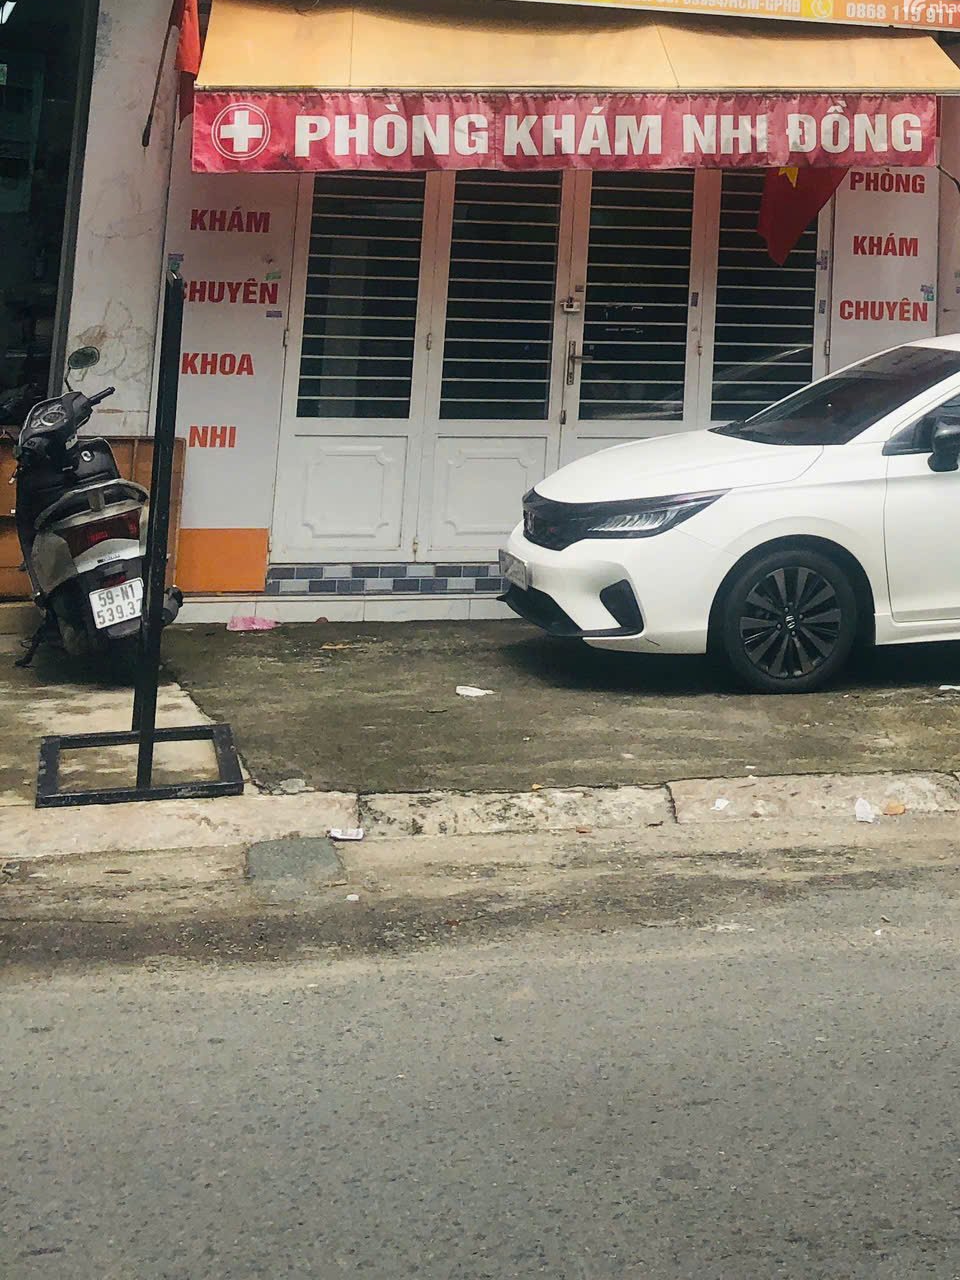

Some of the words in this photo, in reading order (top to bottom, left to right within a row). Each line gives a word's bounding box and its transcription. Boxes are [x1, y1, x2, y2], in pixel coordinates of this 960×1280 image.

[846, 1, 887, 20] 0868
[294, 104, 489, 158] PHÒNG
[504, 106, 662, 156] KHÁM
[682, 114, 768, 155] NHI
[786, 100, 923, 154] ĐỒNG
[850, 168, 926, 194] PHÒNG
[190, 207, 271, 233] KHÁM
[853, 232, 919, 257] KHÁM
[183, 278, 279, 305] HUYÊN
[839, 297, 928, 322] CHUYÊN
[181, 352, 255, 376] KHOA
[188, 425, 237, 449] NHI
[98, 584, 135, 608] 59-N1
